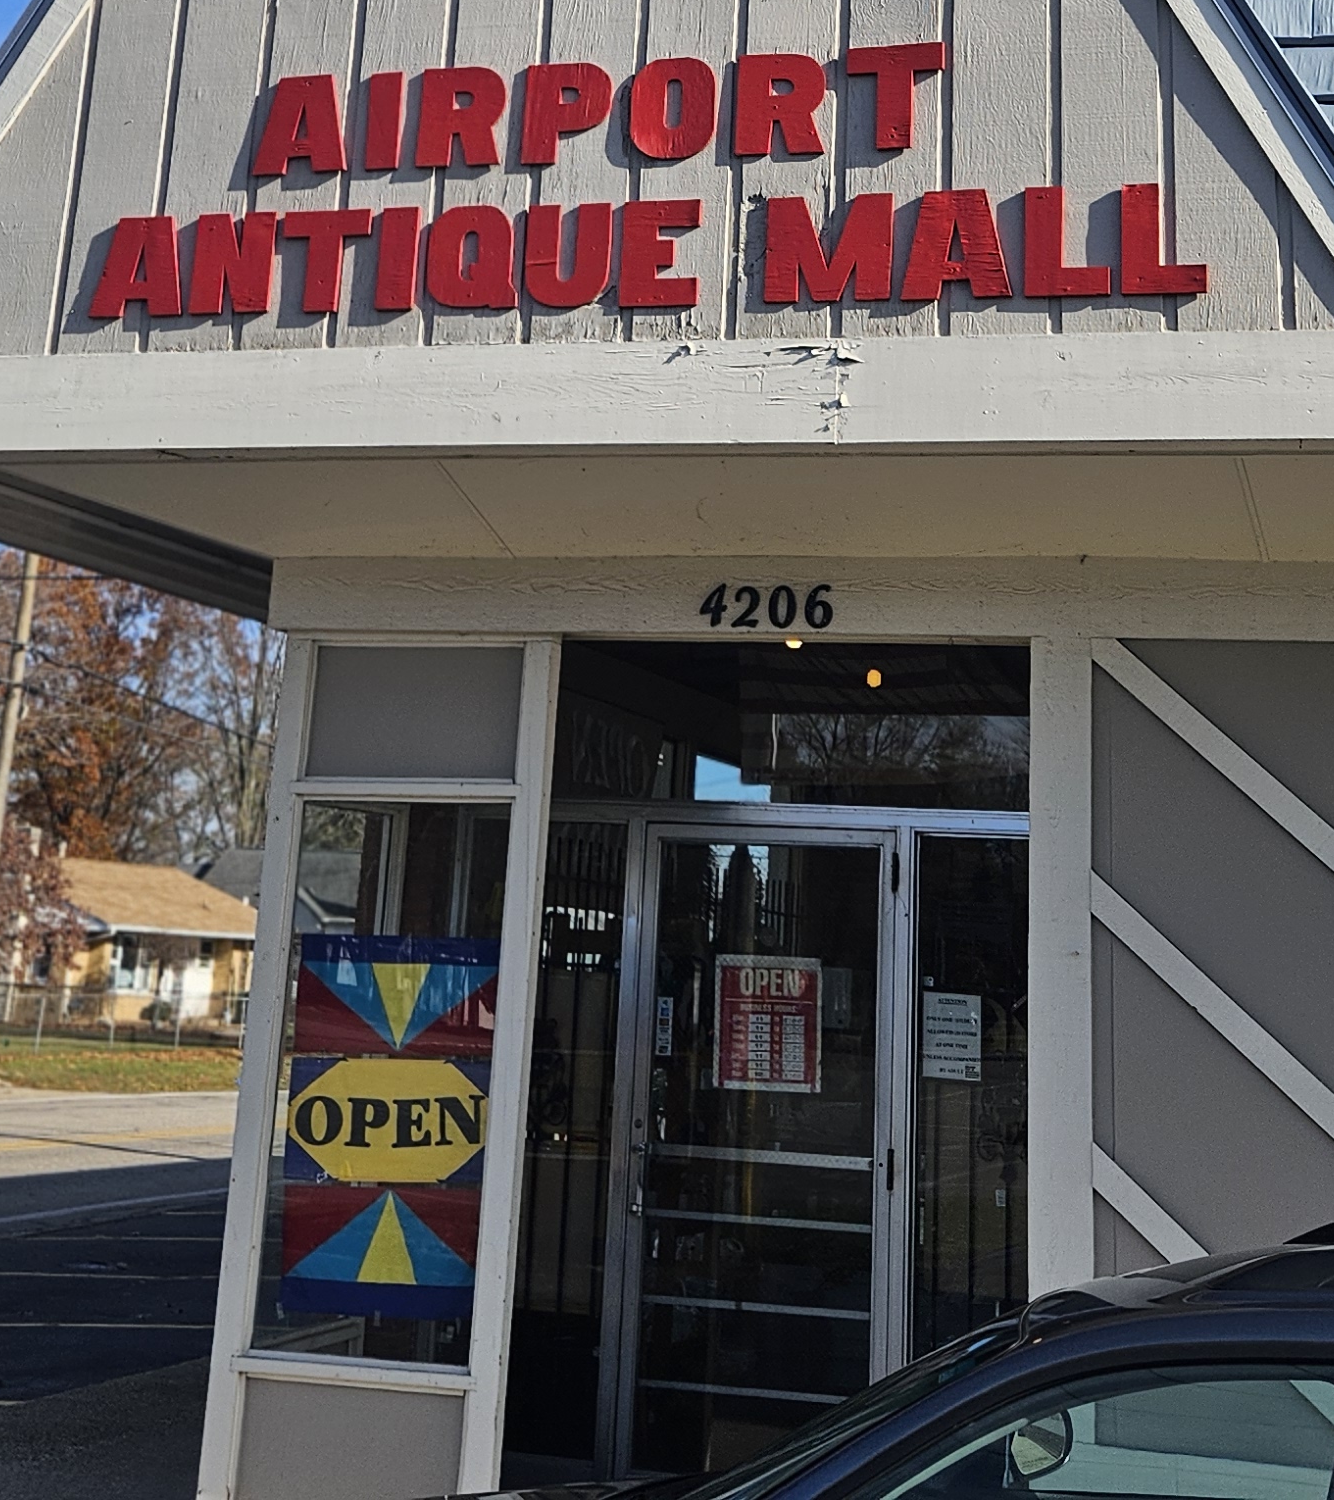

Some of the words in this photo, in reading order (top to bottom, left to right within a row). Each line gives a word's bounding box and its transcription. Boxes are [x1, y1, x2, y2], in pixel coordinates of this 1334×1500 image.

[250, 41, 945, 176] AIRPORT
[87, 197, 704, 318] ANTIQUE
[762, 183, 1208, 304] MALL
[699, 583, 834, 629] 4206
[739, 967, 801, 997] OPEN
[294, 1094, 486, 1149] OPEN
